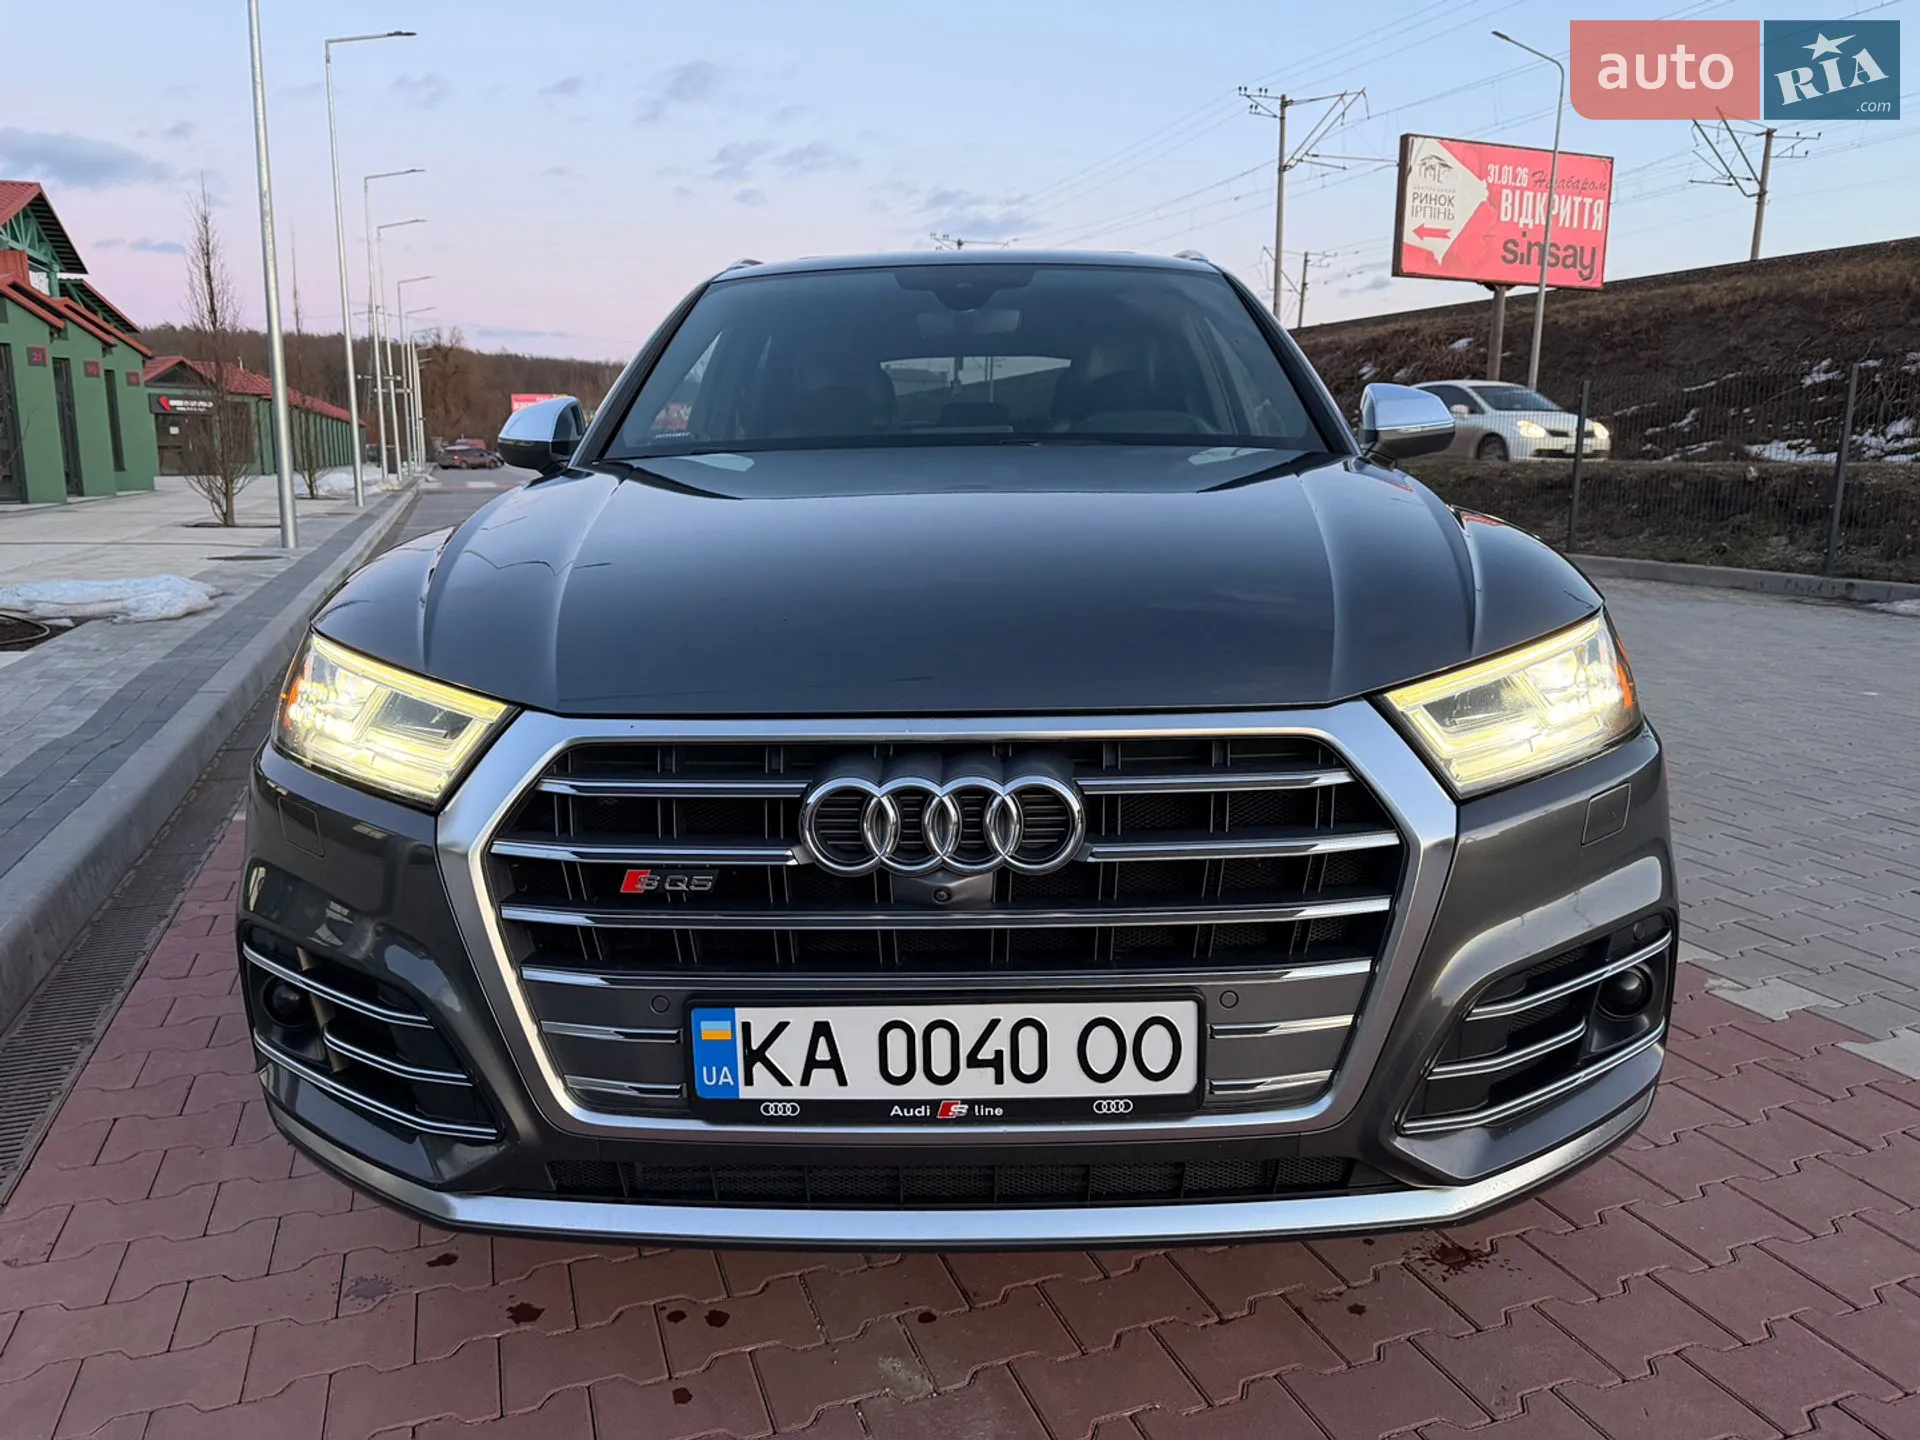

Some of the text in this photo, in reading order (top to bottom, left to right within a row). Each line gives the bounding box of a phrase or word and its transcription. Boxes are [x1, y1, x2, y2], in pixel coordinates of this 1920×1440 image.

[1487, 163, 1529, 187] 31.01.26
[1412, 191, 1455, 207] РИНОК
[1411, 204, 1455, 220] ІРПІНЬ
[1501, 189, 1605, 231] ВІДКРИТТЯ
[1501, 231, 1596, 281] sinsay
[632, 872, 714, 891] SQ5
[741, 1015, 1182, 1087] KA 0040 OO
[702, 1065, 734, 1086] UA
[890, 1105, 931, 1117] Audi
[974, 1104, 1004, 1117] line
